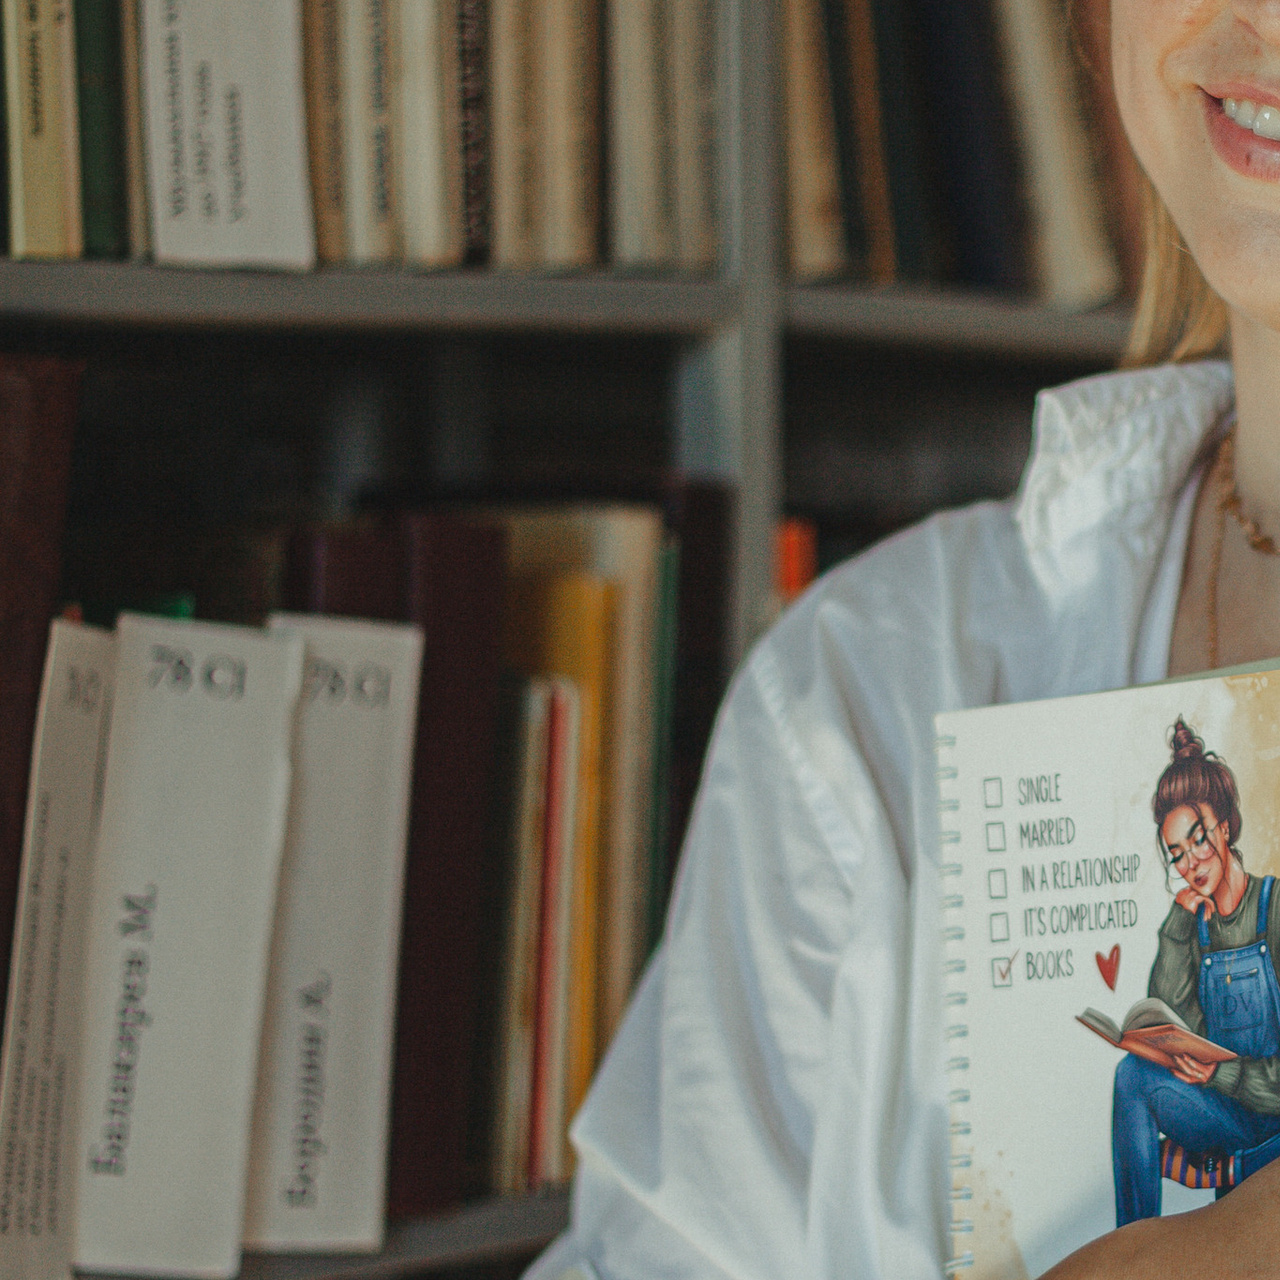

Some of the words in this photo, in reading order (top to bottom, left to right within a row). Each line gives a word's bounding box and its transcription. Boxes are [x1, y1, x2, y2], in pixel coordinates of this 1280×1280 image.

[1018, 773, 1062, 806] SINGLE
[1019, 817, 1076, 849] MARRIED
[1021, 865, 1035, 893] IN
[1040, 864, 1050, 891] A
[1052, 853, 1141, 890] RELATIONSHIP
[1023, 906, 1047, 937] IT'S
[1050, 899, 1139, 935] COMPLICATED
[1025, 948, 1074, 980] BOOKS
